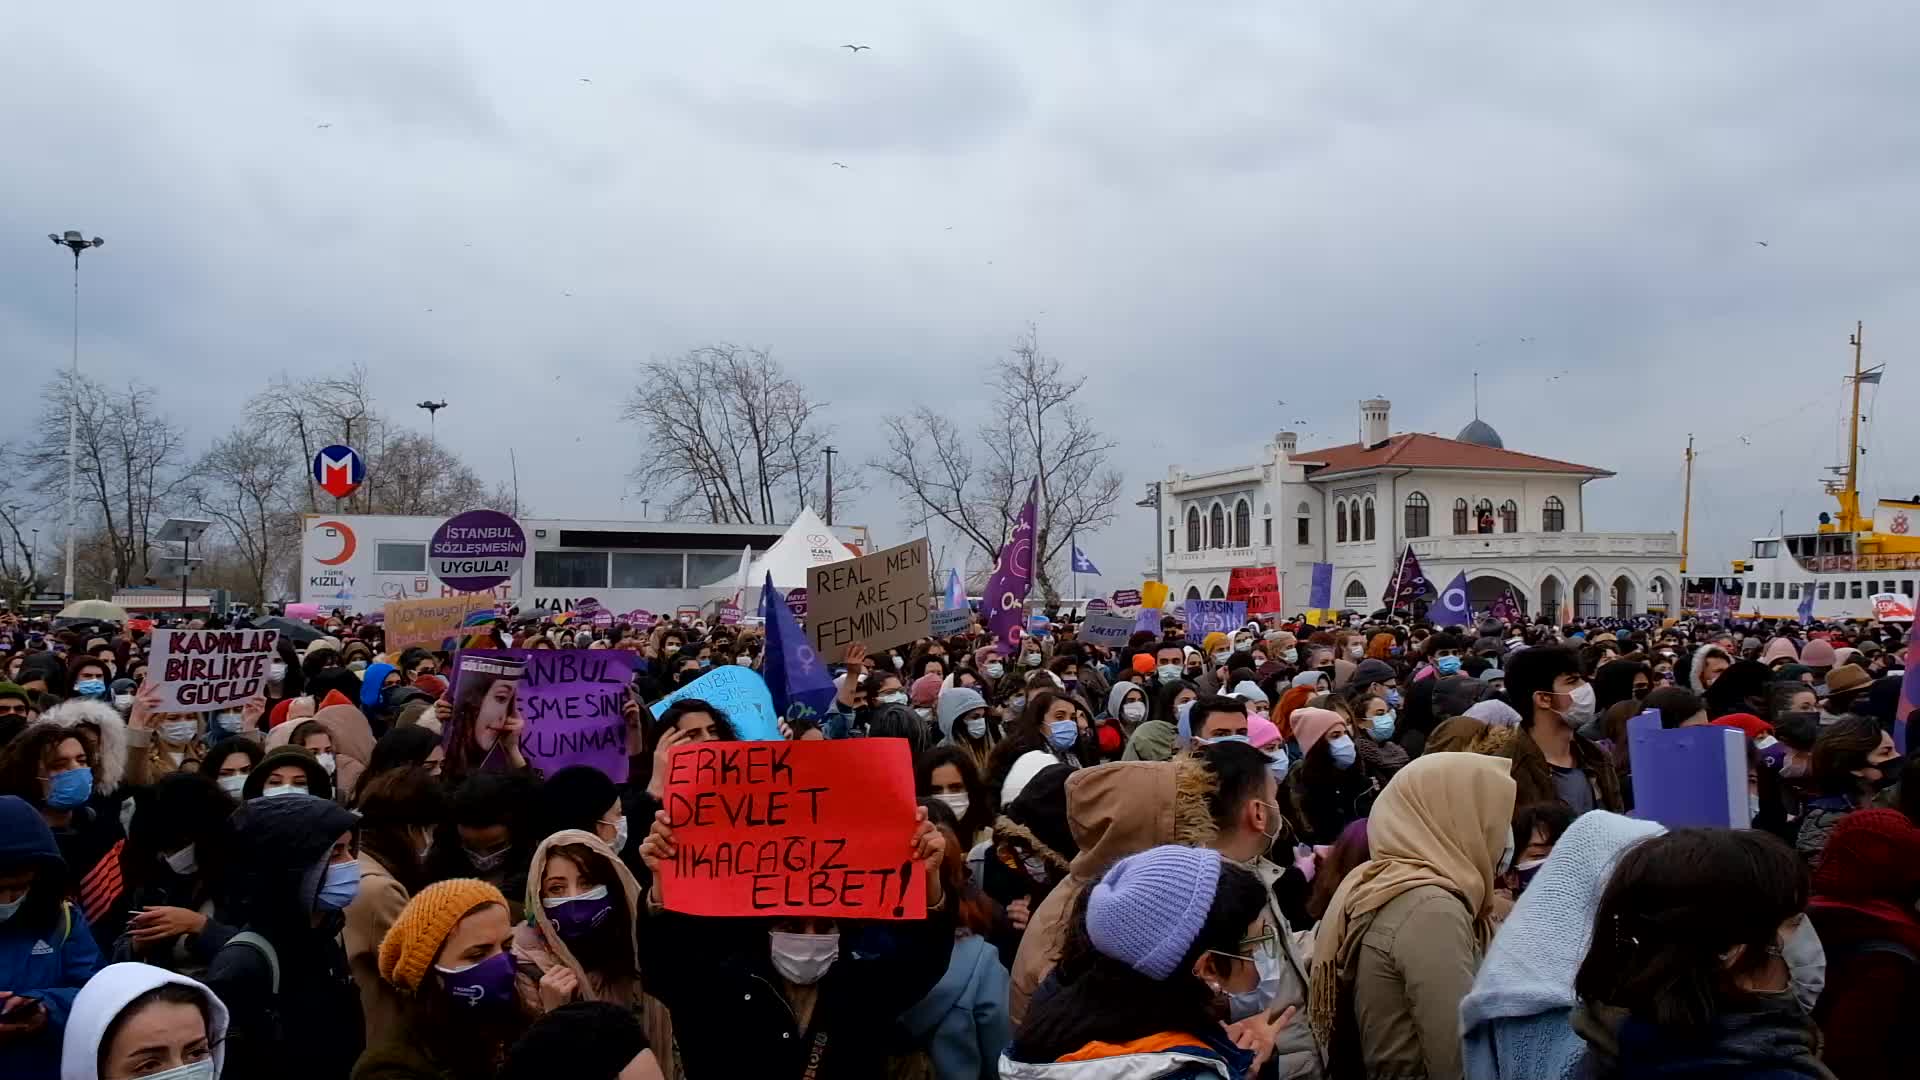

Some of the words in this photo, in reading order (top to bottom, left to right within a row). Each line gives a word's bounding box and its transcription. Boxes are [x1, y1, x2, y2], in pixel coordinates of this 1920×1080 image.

[446, 525, 516, 540] İSTANBUL
[434, 541, 524, 555] SÖZLEŞMESİNİ
[441, 560, 509, 573] UYGULA!
[816, 563, 873, 595] REAL
[887, 547, 922, 575] MEN
[310, 576, 356, 587] KIZILY
[856, 581, 891, 609] ARE
[816, 593, 928, 652] FEMINISTS
[169, 630, 276, 654] KADINLAR
[165, 655, 267, 681] BİRLİKTE
[518, 726, 629, 759] KUNMA!
[669, 747, 793, 785] ERKEK
[669, 787, 830, 828] DEVLET
[752, 861, 913, 918] ELBET!
